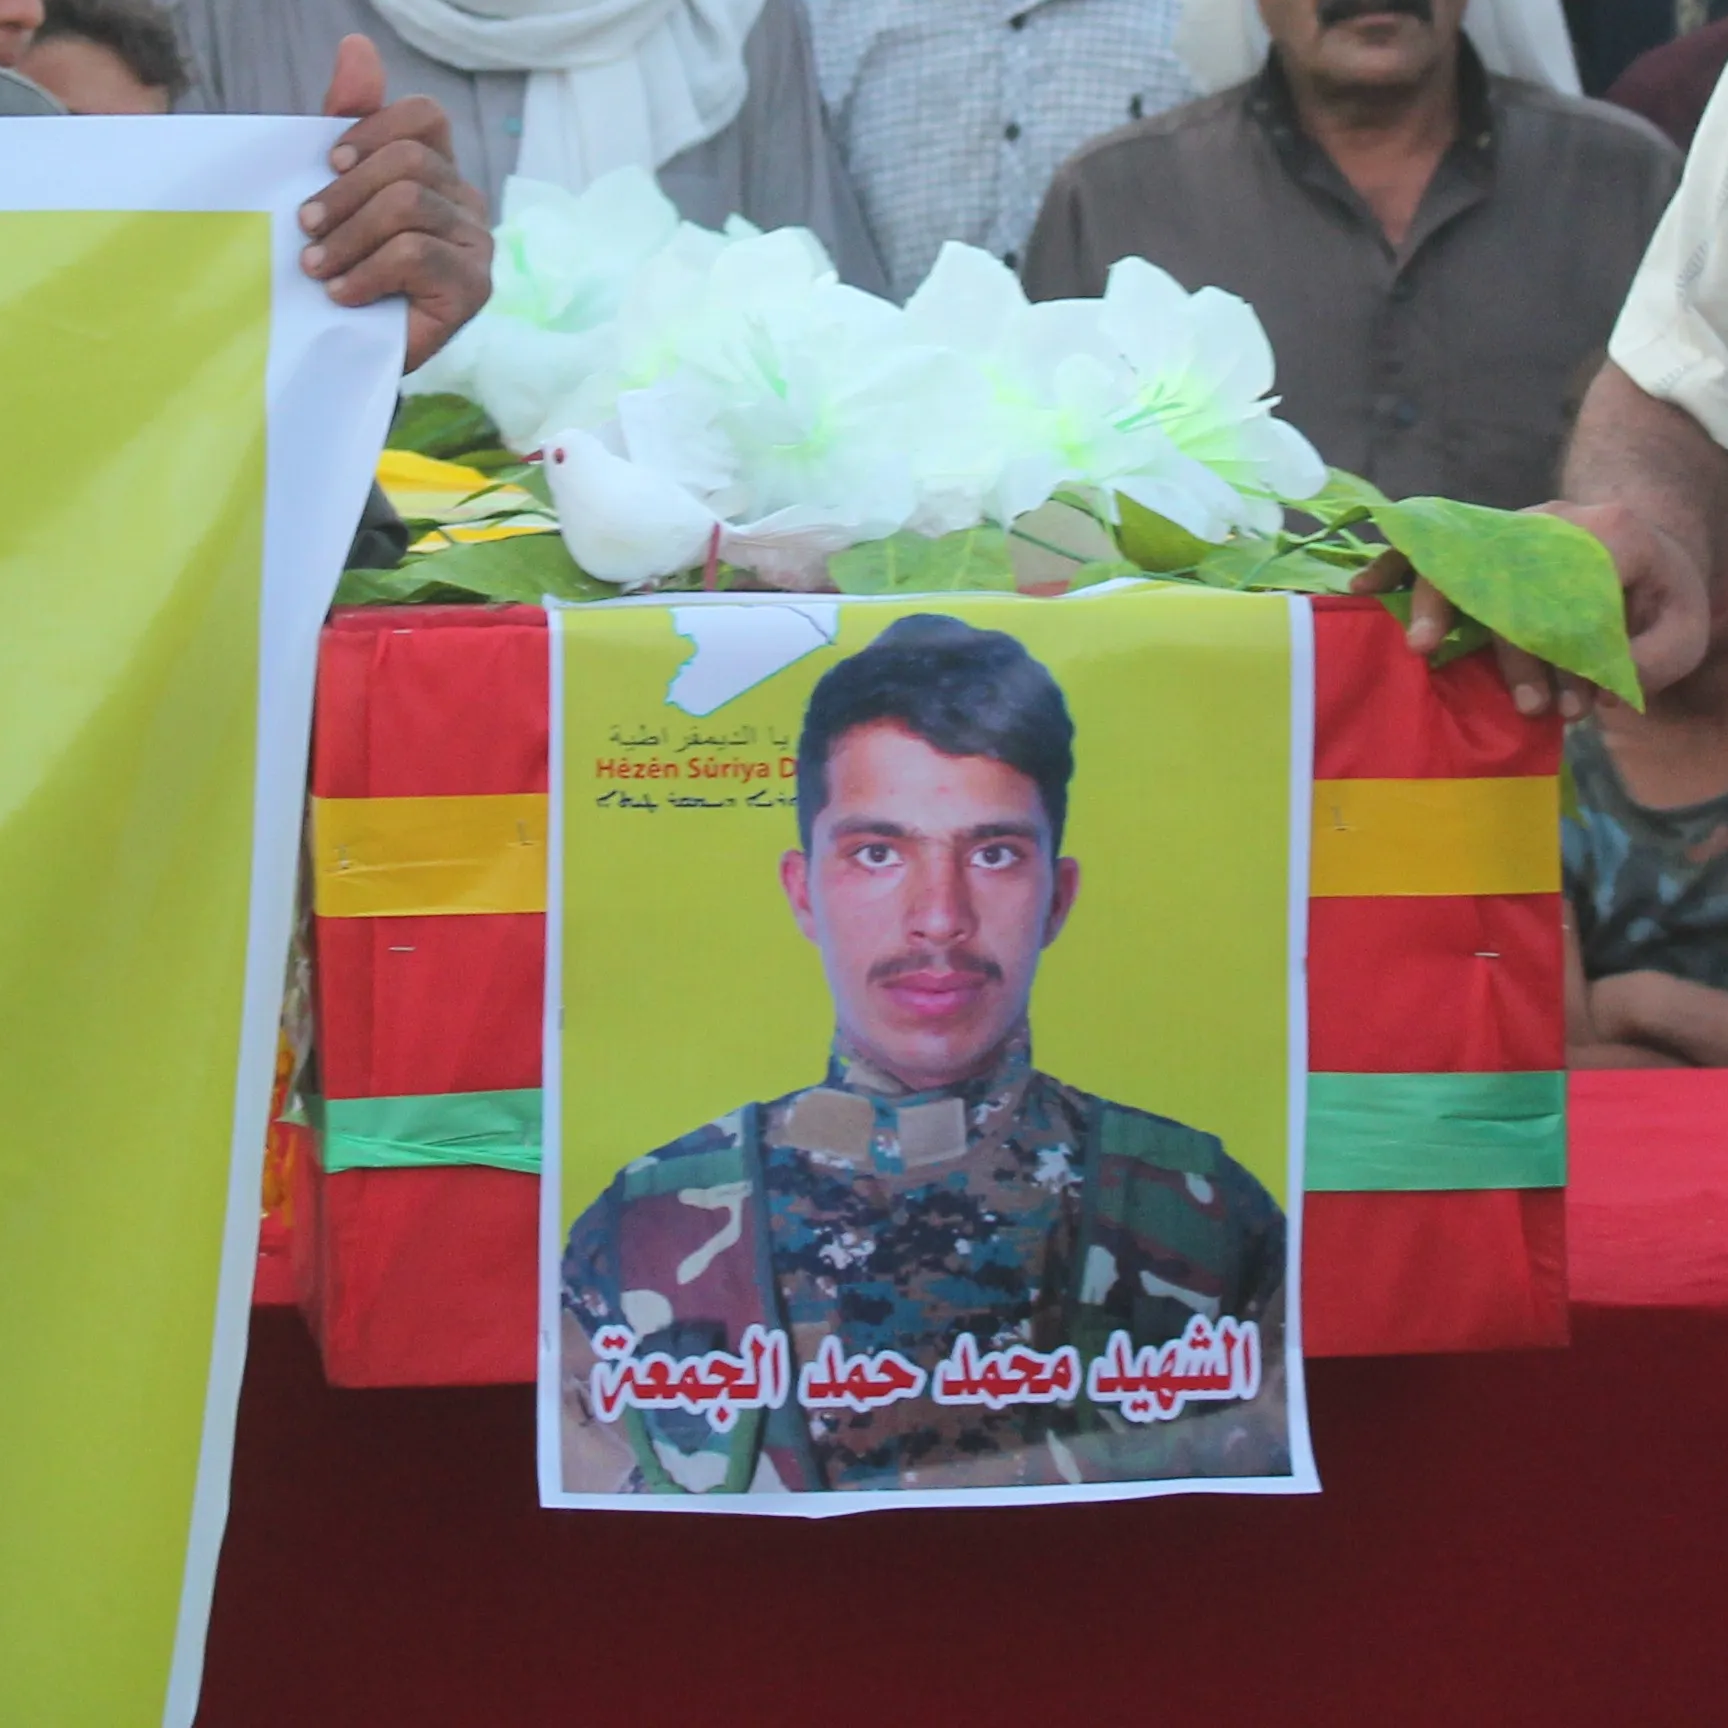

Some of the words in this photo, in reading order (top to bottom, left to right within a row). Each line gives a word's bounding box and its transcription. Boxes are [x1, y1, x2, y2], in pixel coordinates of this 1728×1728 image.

[594, 756, 680, 780] Hêzên
[686, 756, 771, 784] Sûriya
[594, 1328, 786, 1428] الجمعة
[802, 1339, 924, 1408] حمد
[936, 1337, 1078, 1405] محمد
[1091, 1318, 1256, 1417] الشهيد
